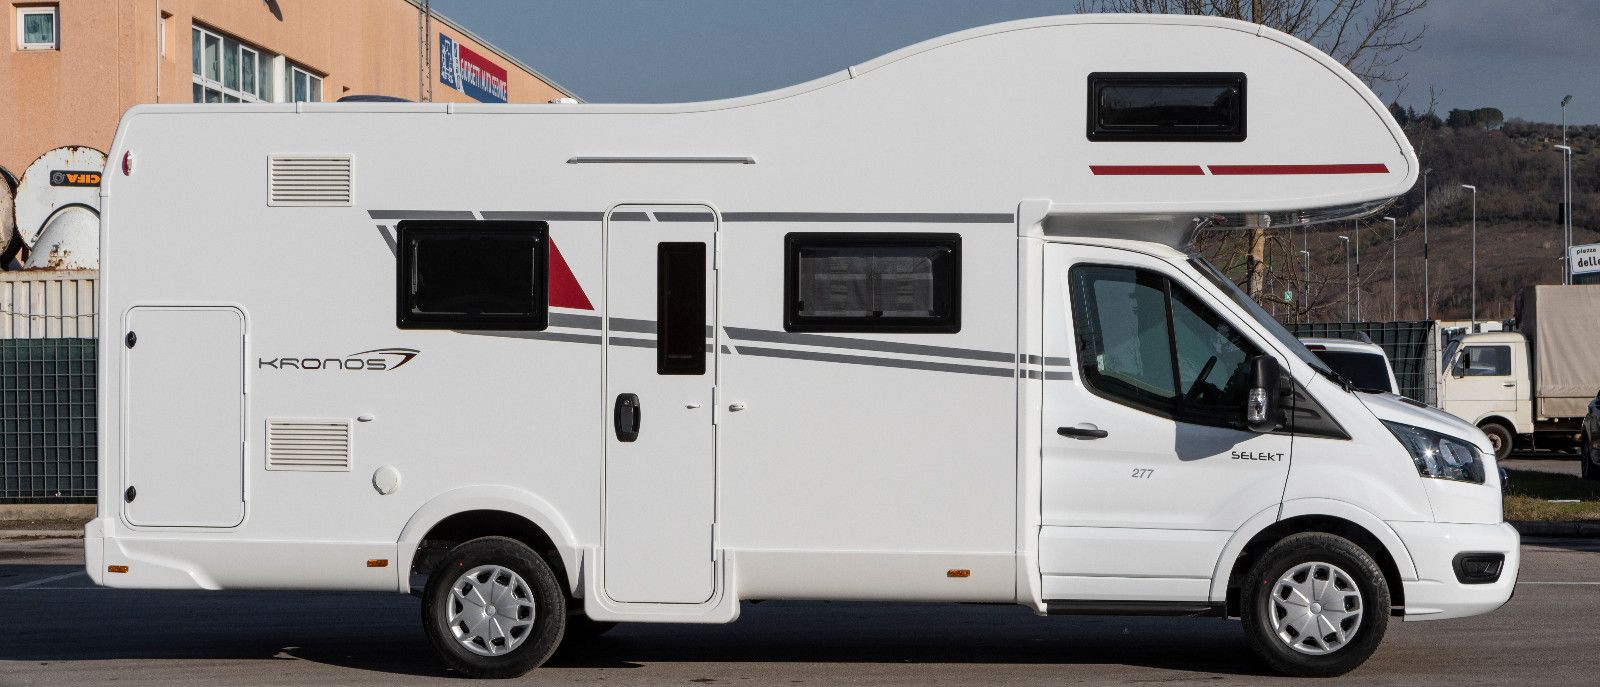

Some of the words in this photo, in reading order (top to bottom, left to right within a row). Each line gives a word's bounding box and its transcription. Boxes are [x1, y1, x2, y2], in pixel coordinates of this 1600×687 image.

[66, 173, 101, 184] CIFA
[258, 357, 387, 370] KRONOS
[1231, 451, 1284, 461] SELEKT
[1131, 468, 1154, 479] 277
